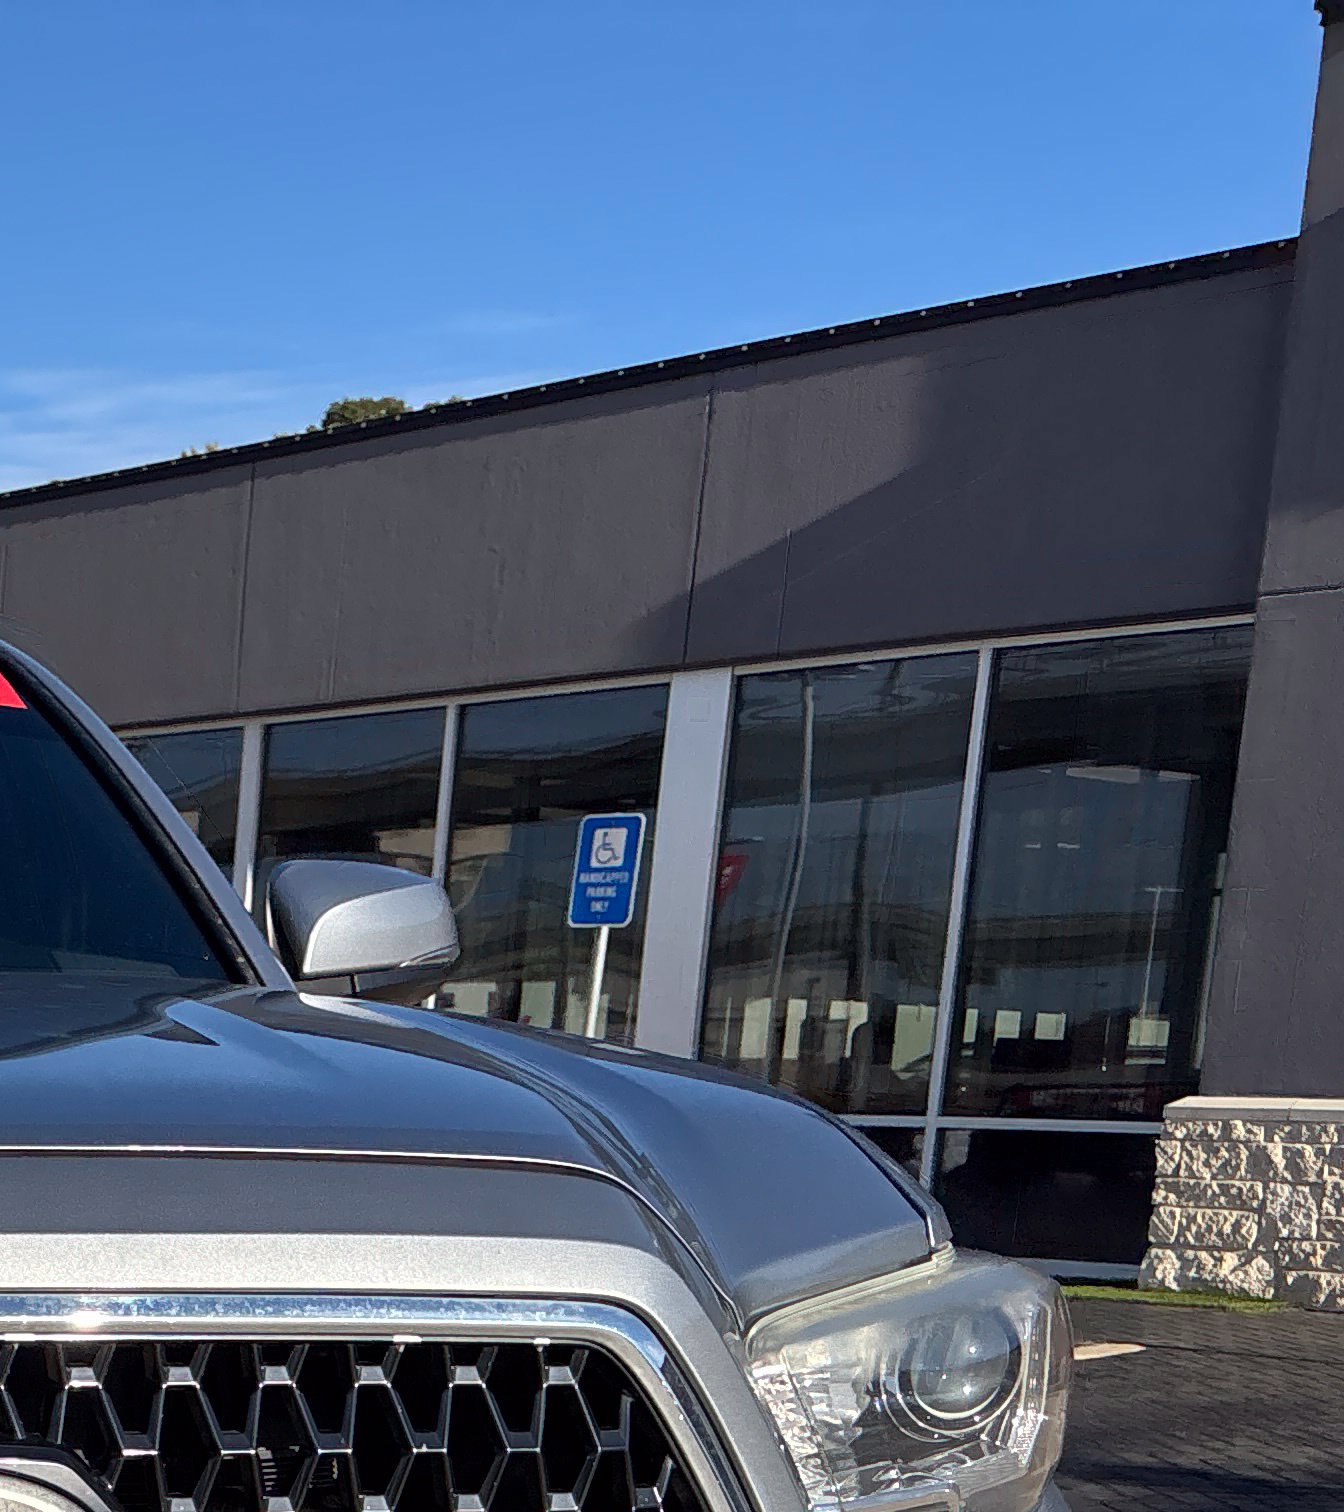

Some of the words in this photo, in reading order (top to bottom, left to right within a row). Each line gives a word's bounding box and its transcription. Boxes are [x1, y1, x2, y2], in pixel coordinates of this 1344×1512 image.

[578, 871, 630, 884] HANDICAPPED
[585, 886, 617, 898] PARKING
[590, 900, 609, 913] ONLY
